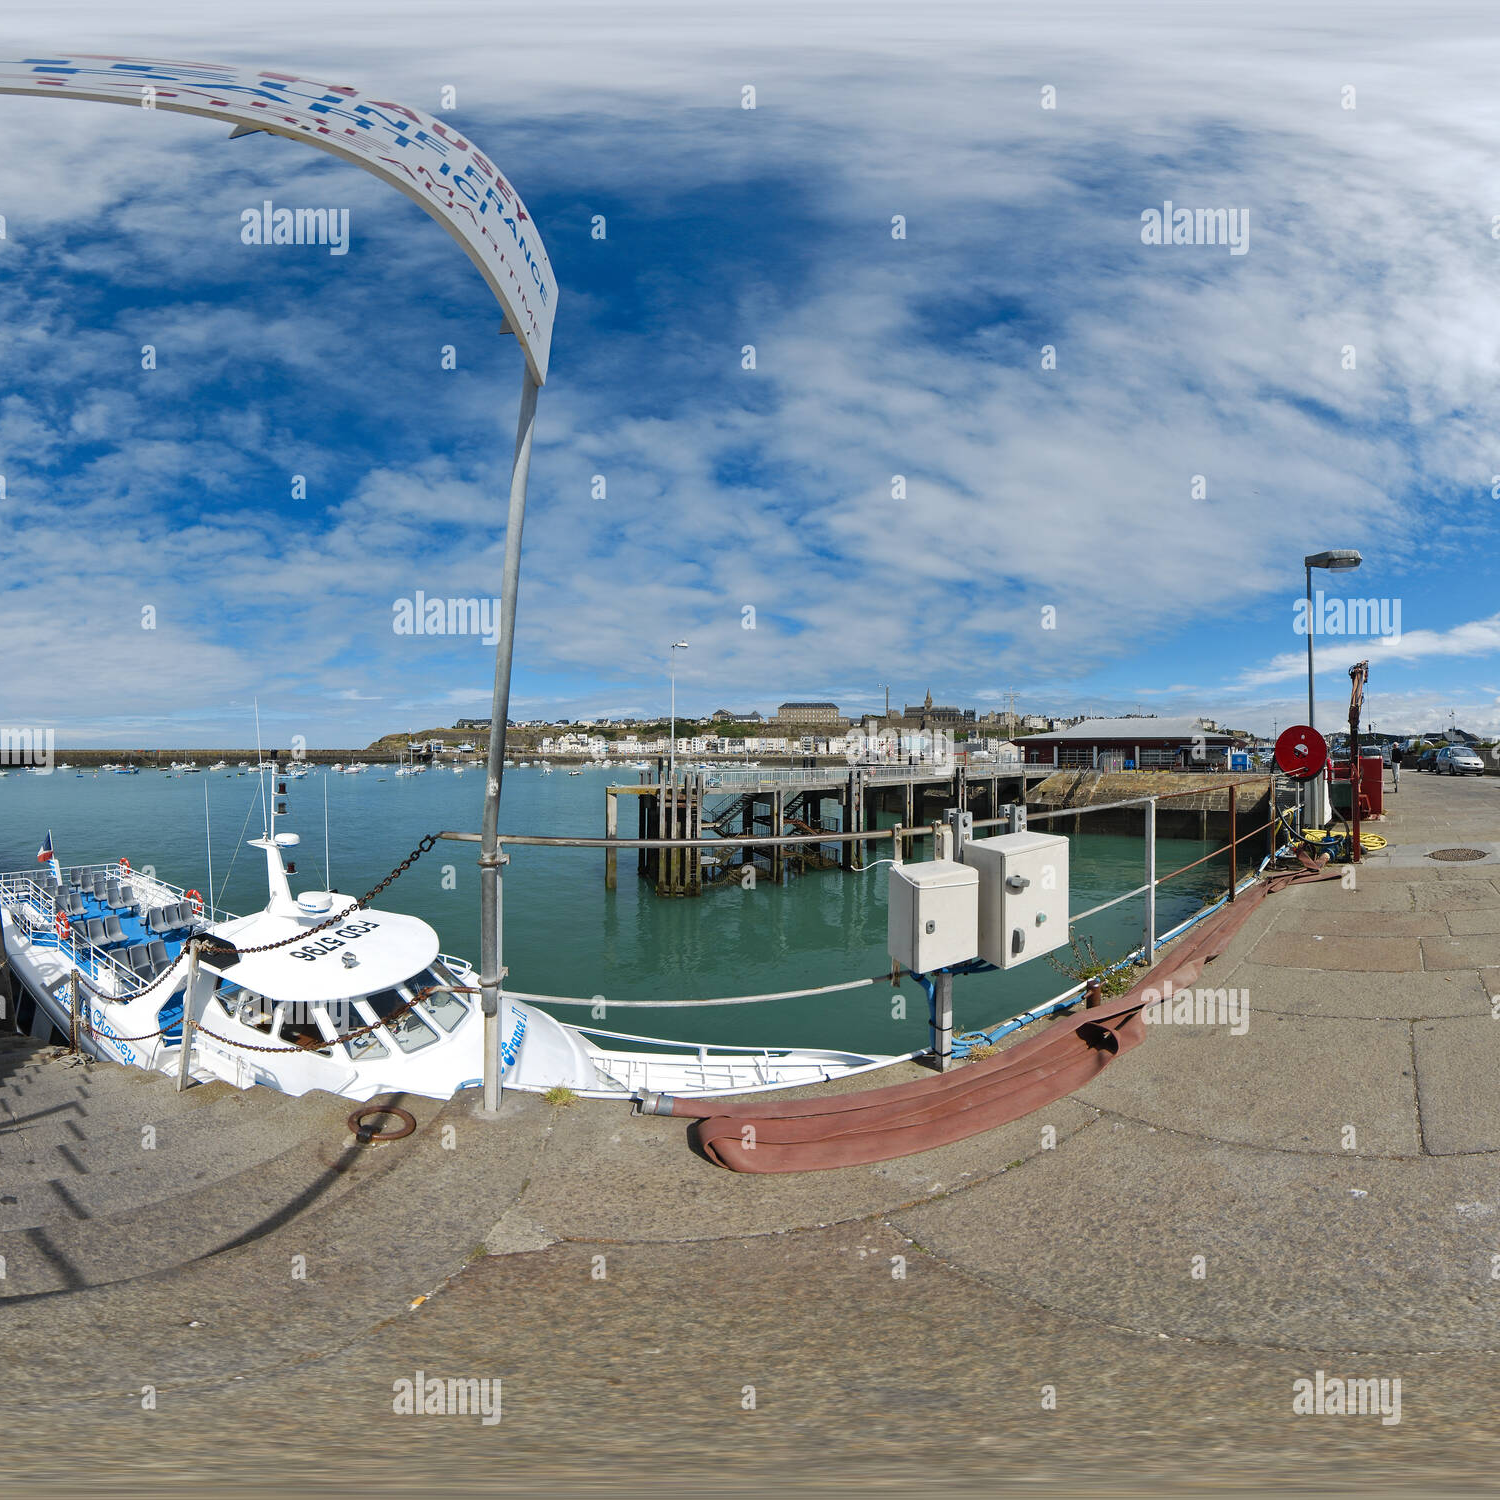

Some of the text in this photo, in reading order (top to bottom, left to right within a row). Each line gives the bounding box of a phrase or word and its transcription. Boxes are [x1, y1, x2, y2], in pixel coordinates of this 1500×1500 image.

[56, 52, 528, 228] CHAUSEY
[438, 162, 488, 215] ICI
[463, 165, 548, 307] FRANCE
[289, 920, 380, 962] FGD 5796
[93, 1009, 136, 1065] Chausey
[501, 1019, 526, 1066] France
